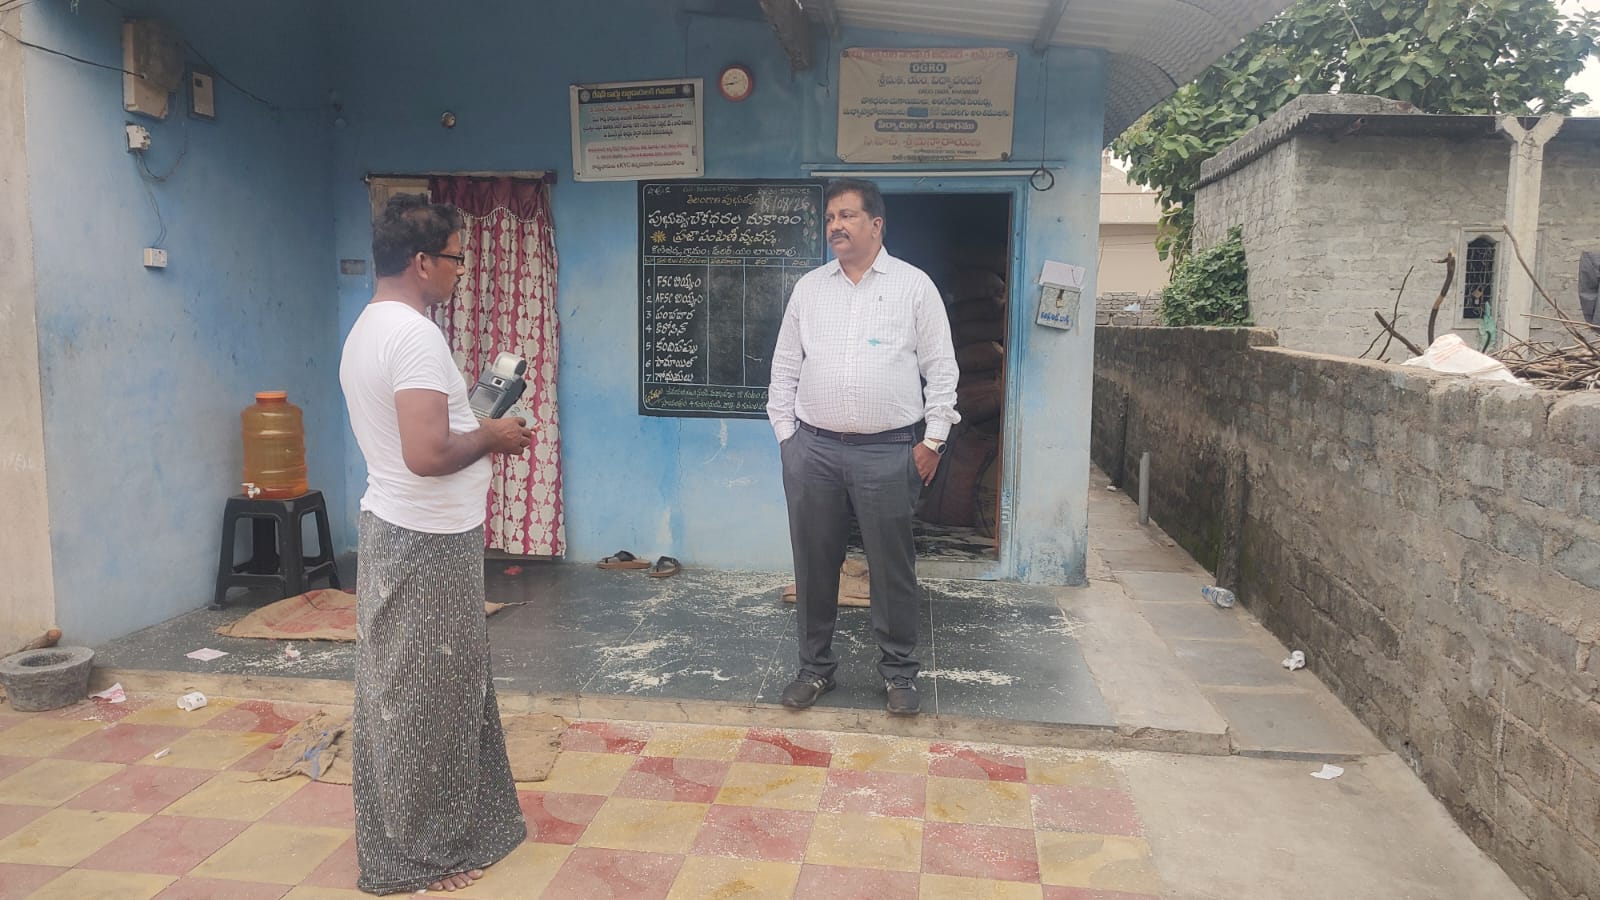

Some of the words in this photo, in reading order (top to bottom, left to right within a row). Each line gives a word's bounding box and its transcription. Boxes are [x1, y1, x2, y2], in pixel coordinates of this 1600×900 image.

[657, 275, 672, 288] FSC
[656, 293, 673, 304] AFSC
[646, 310, 652, 319] 3
[645, 325, 652, 333] 4
[646, 342, 651, 351] 5
[645, 360, 651, 368] 6
[646, 374, 651, 382] 7
